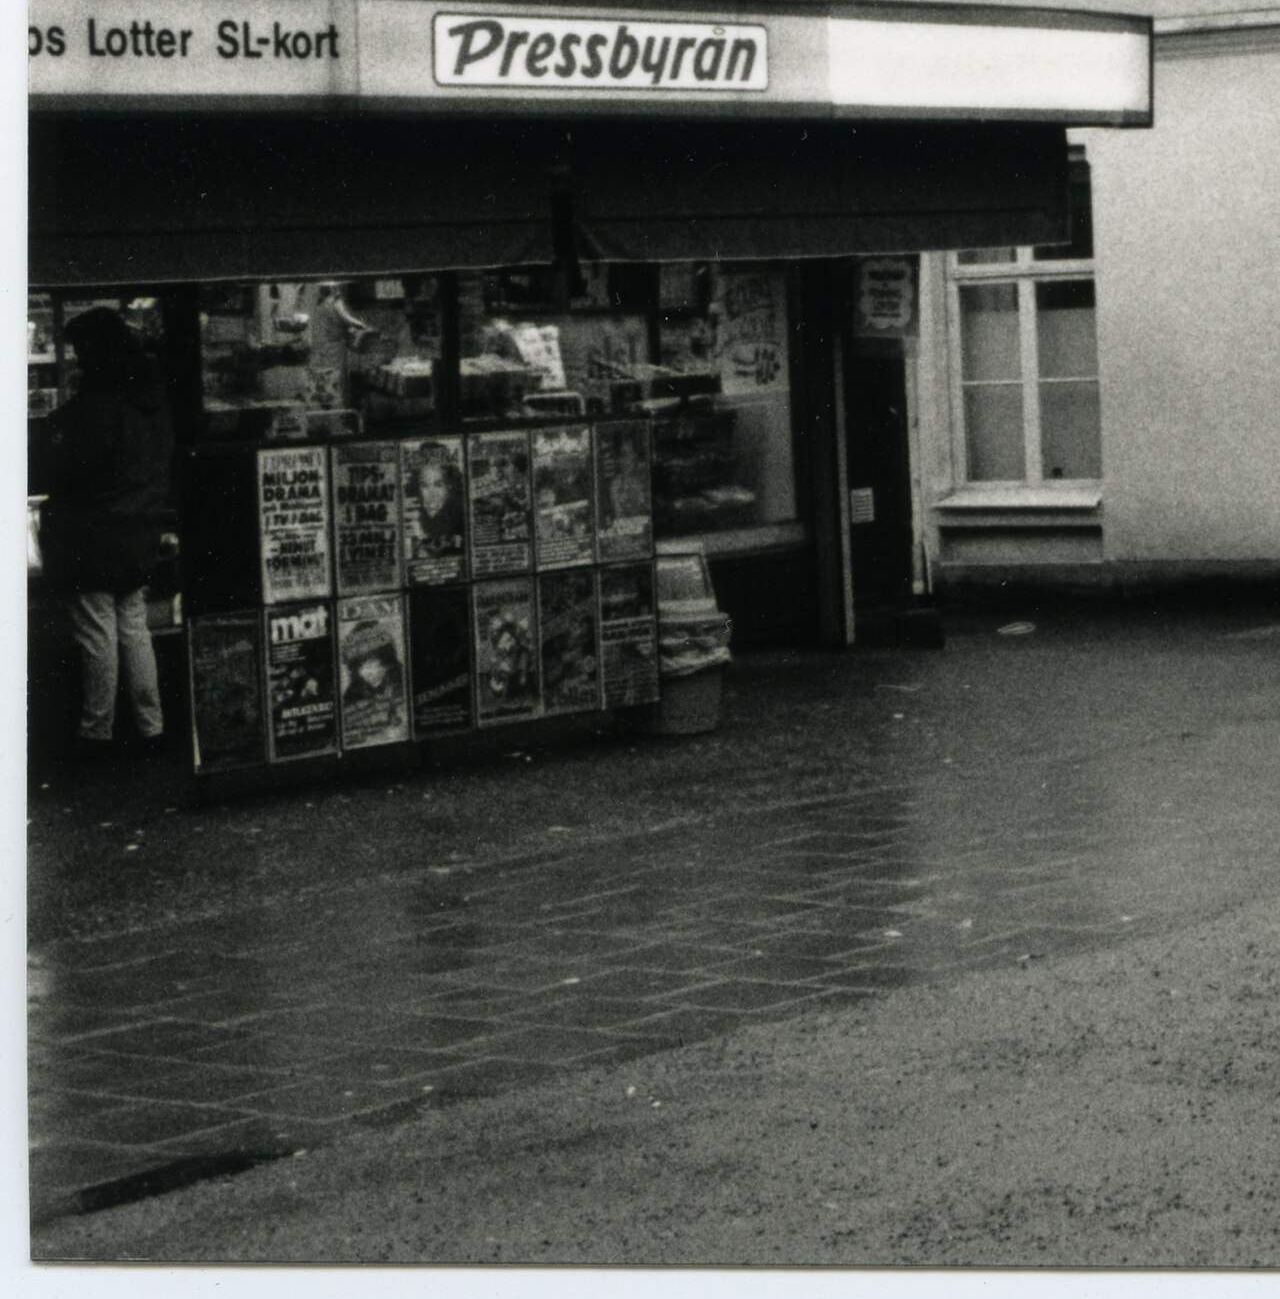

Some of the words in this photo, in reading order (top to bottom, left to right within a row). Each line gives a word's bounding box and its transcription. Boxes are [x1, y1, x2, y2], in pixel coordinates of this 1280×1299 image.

[88, 17, 193, 58] Lotter
[216, 19, 340, 60] SL-kort
[447, 19, 758, 86] Pressbyrån
[263, 485, 321, 501] DRAMA
